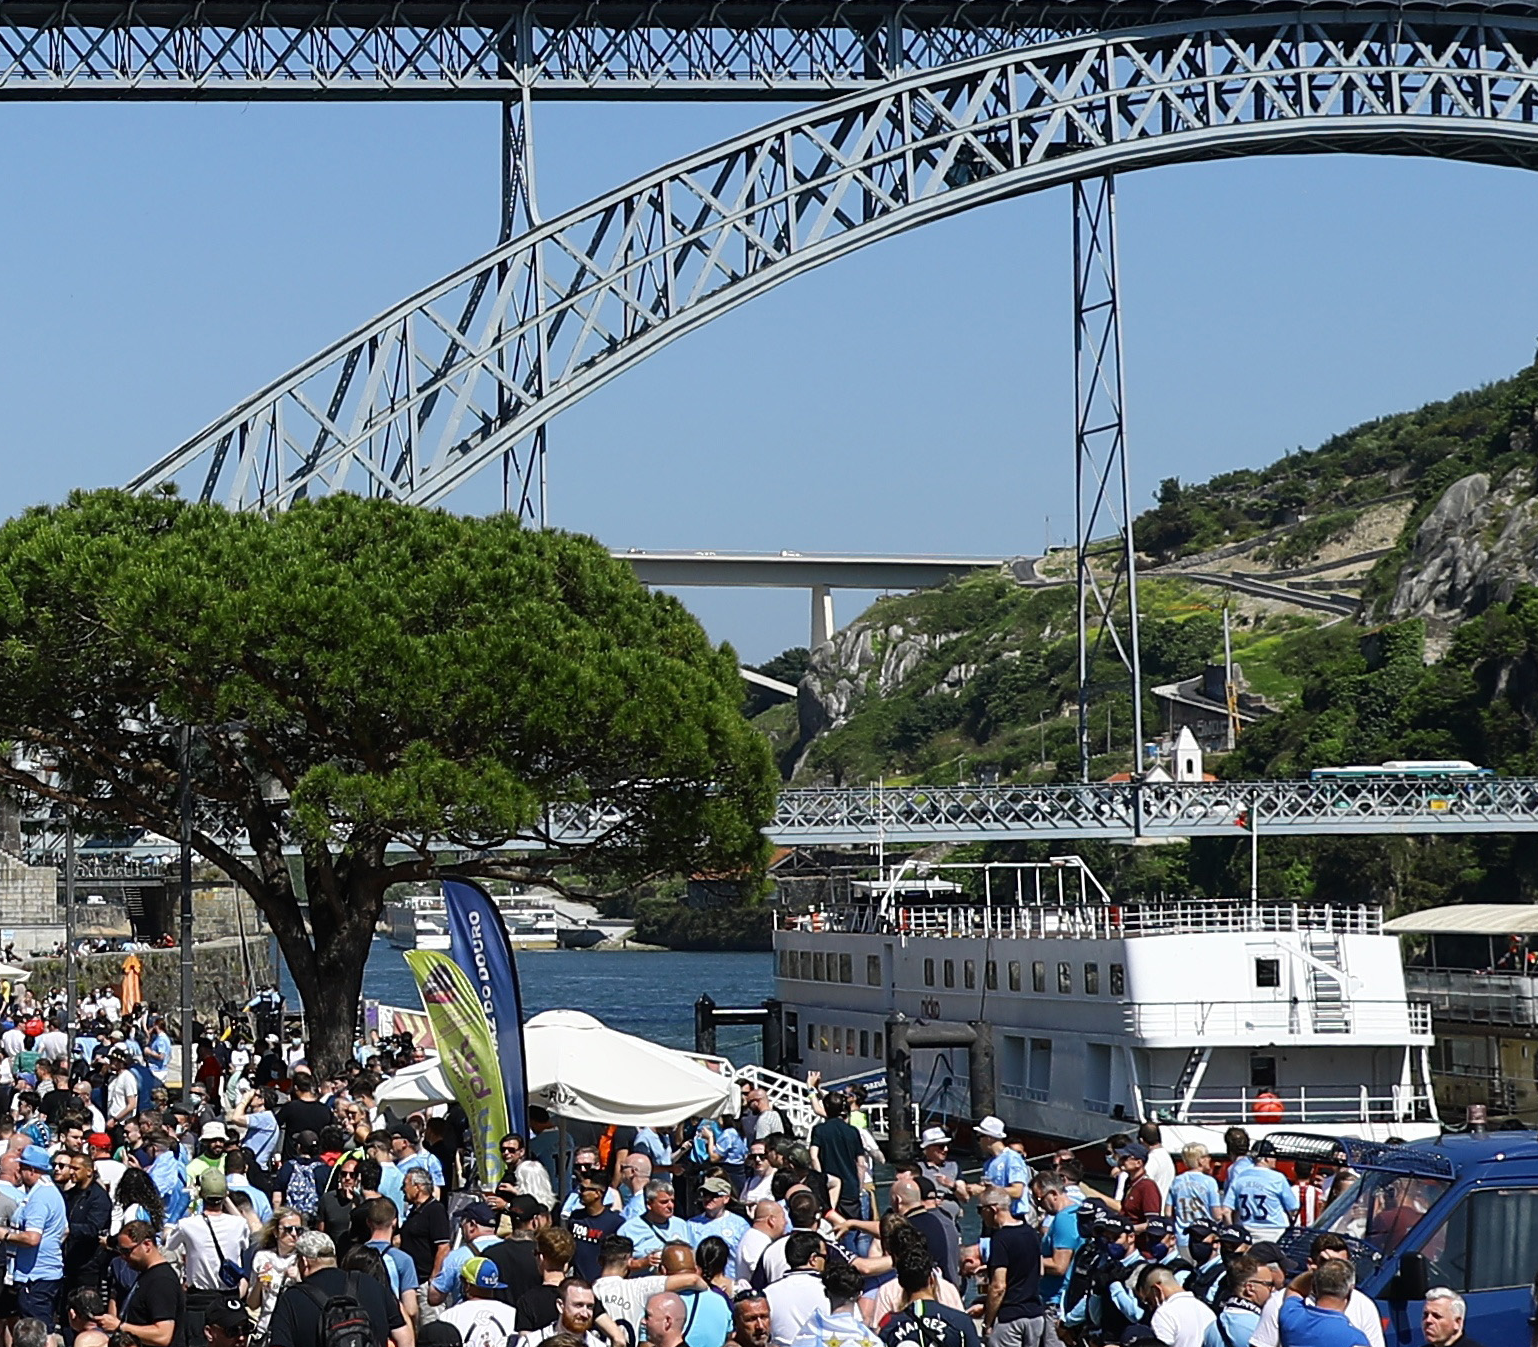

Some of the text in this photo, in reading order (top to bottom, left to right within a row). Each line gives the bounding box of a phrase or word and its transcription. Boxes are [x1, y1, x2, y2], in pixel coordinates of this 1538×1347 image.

[469, 910, 490, 981] DOURO
[481, 985, 493, 1015] DO
[1237, 1194, 1268, 1220] 33
